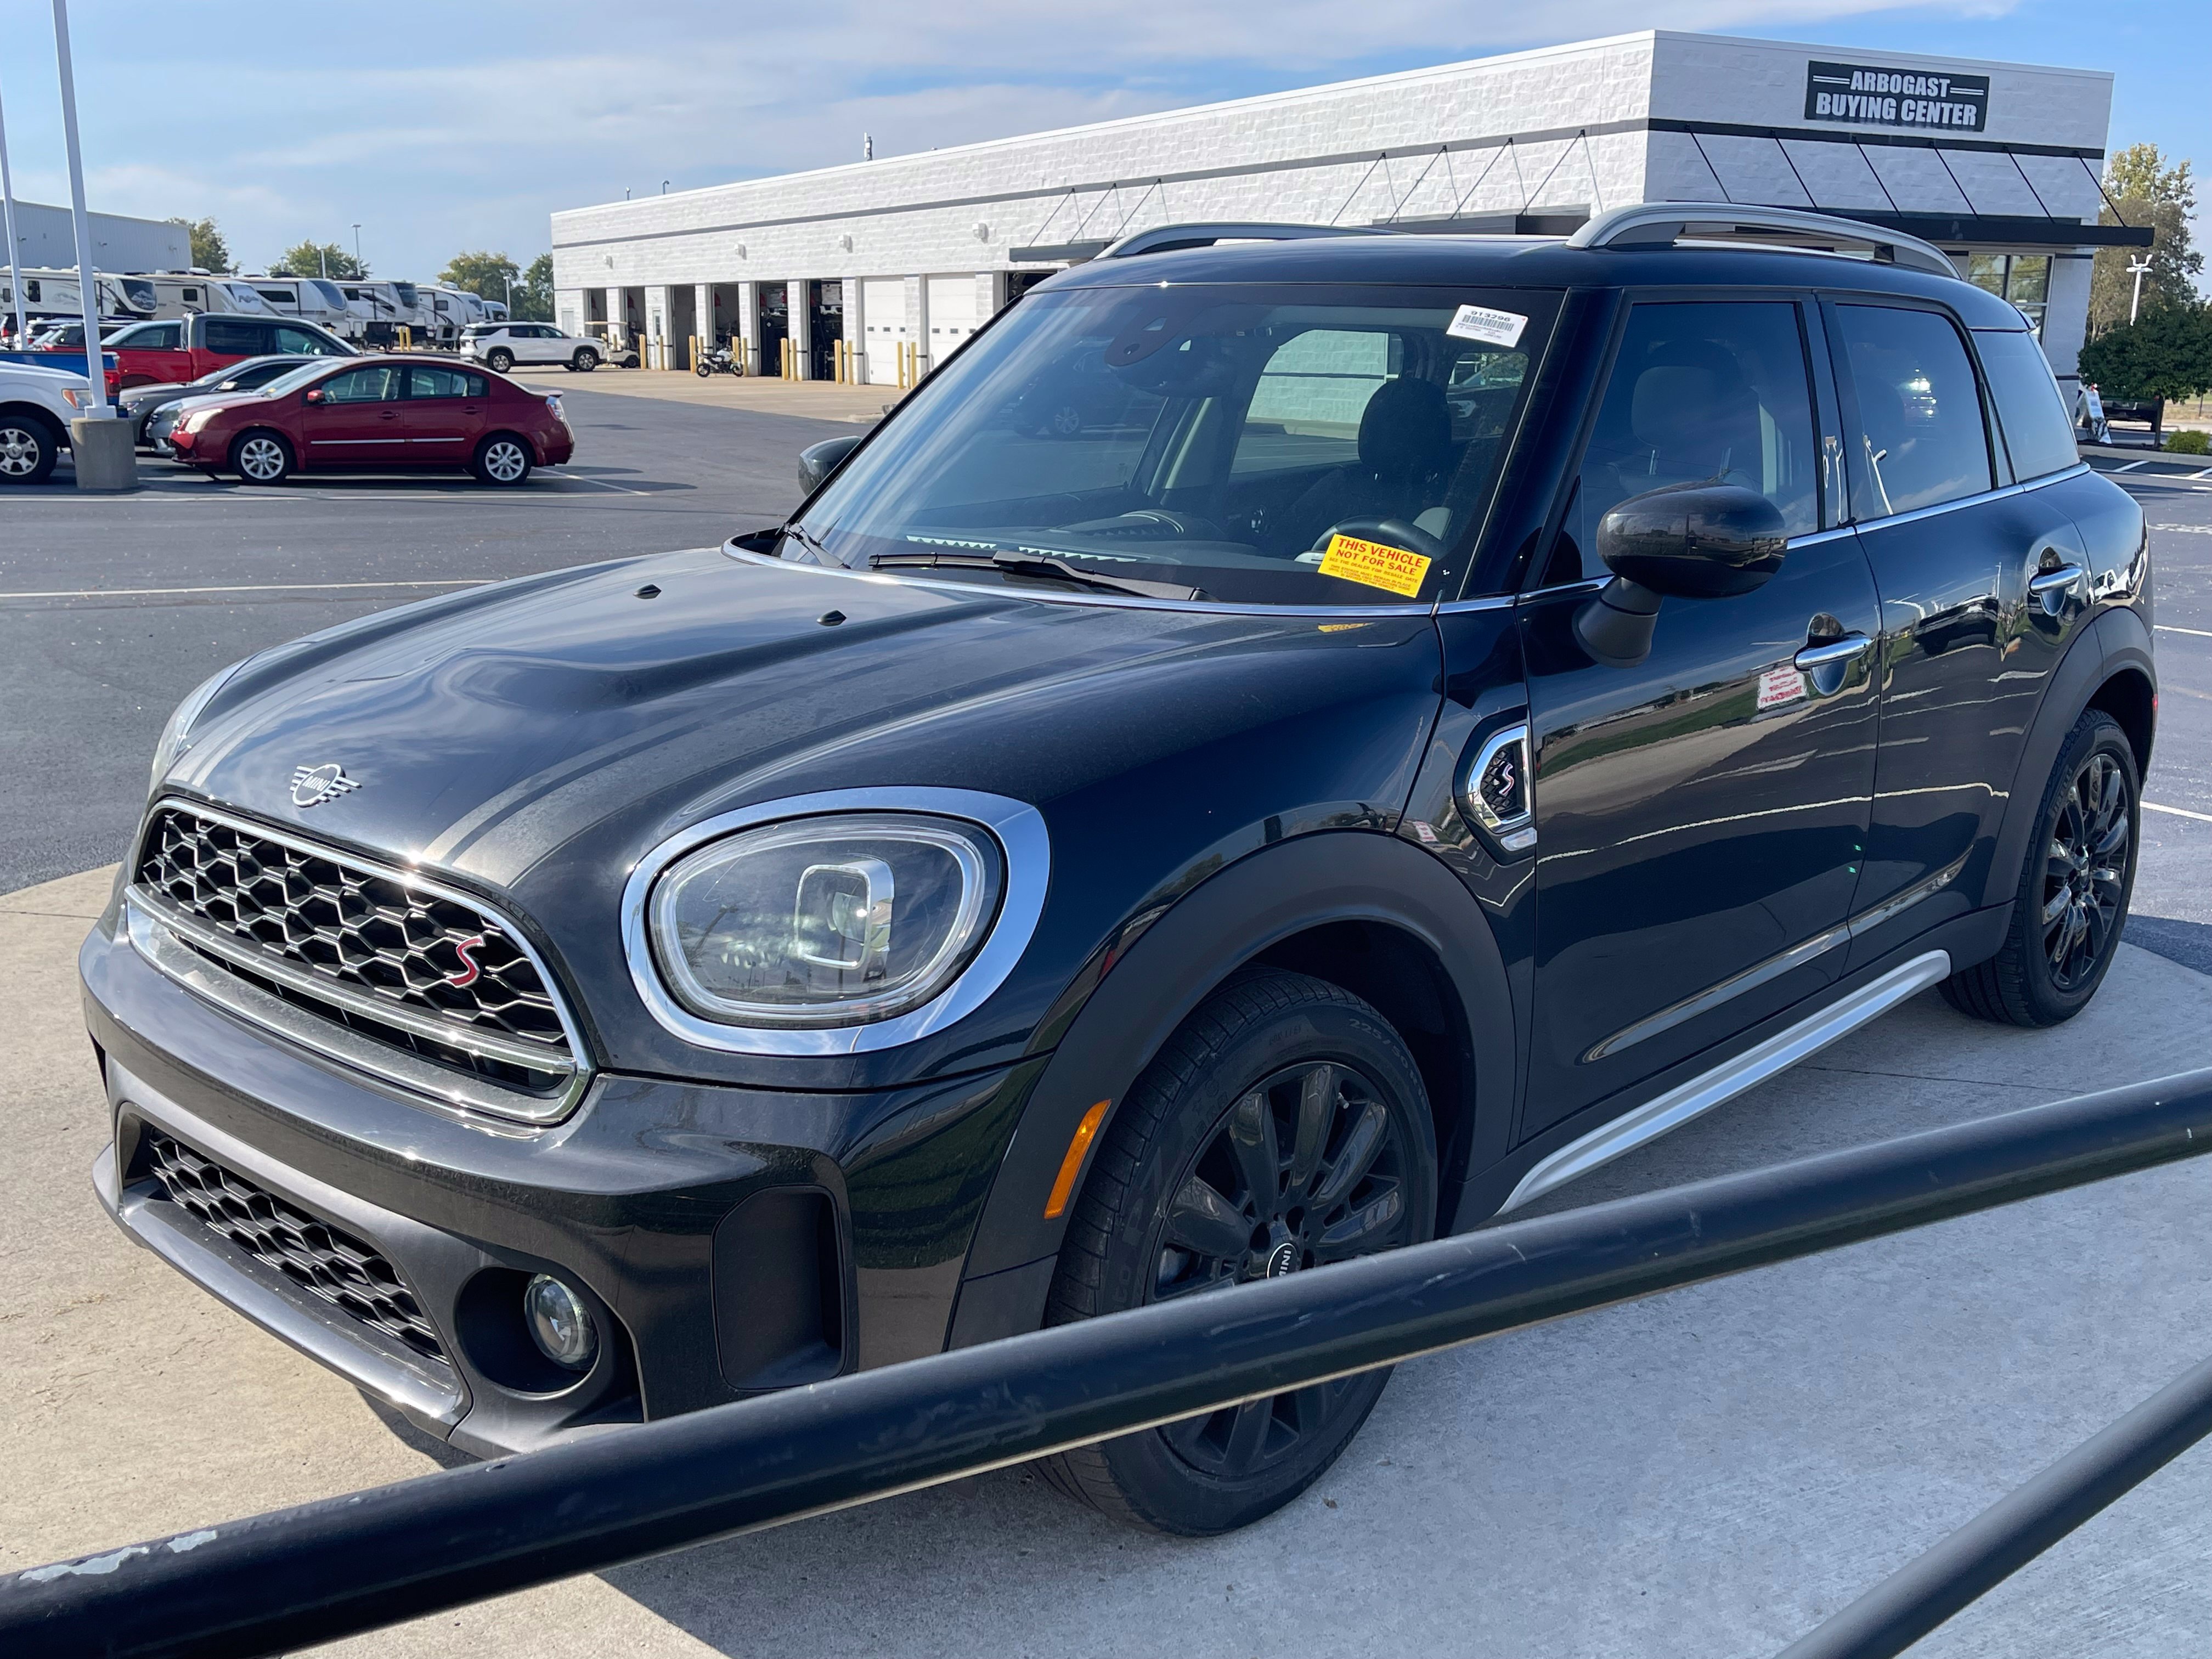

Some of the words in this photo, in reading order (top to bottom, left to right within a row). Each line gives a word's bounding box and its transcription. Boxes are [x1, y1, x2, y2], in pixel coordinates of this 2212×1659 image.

[1850, 70, 1951, 98] ARBOGAST
[1815, 92, 1897, 120] BUYING
[1900, 99, 1977, 126] CENTER
[1336, 549, 1360, 561] NOT
[1362, 556, 1385, 567] FOR
[1388, 562, 1417, 576] SALE
[1338, 538, 1368, 552] THIS
[1370, 545, 1425, 568] VEHICLE
[1384, 571, 1403, 579] RESALE
[302, 775, 331, 792] MINI
[445, 934, 487, 989] S
